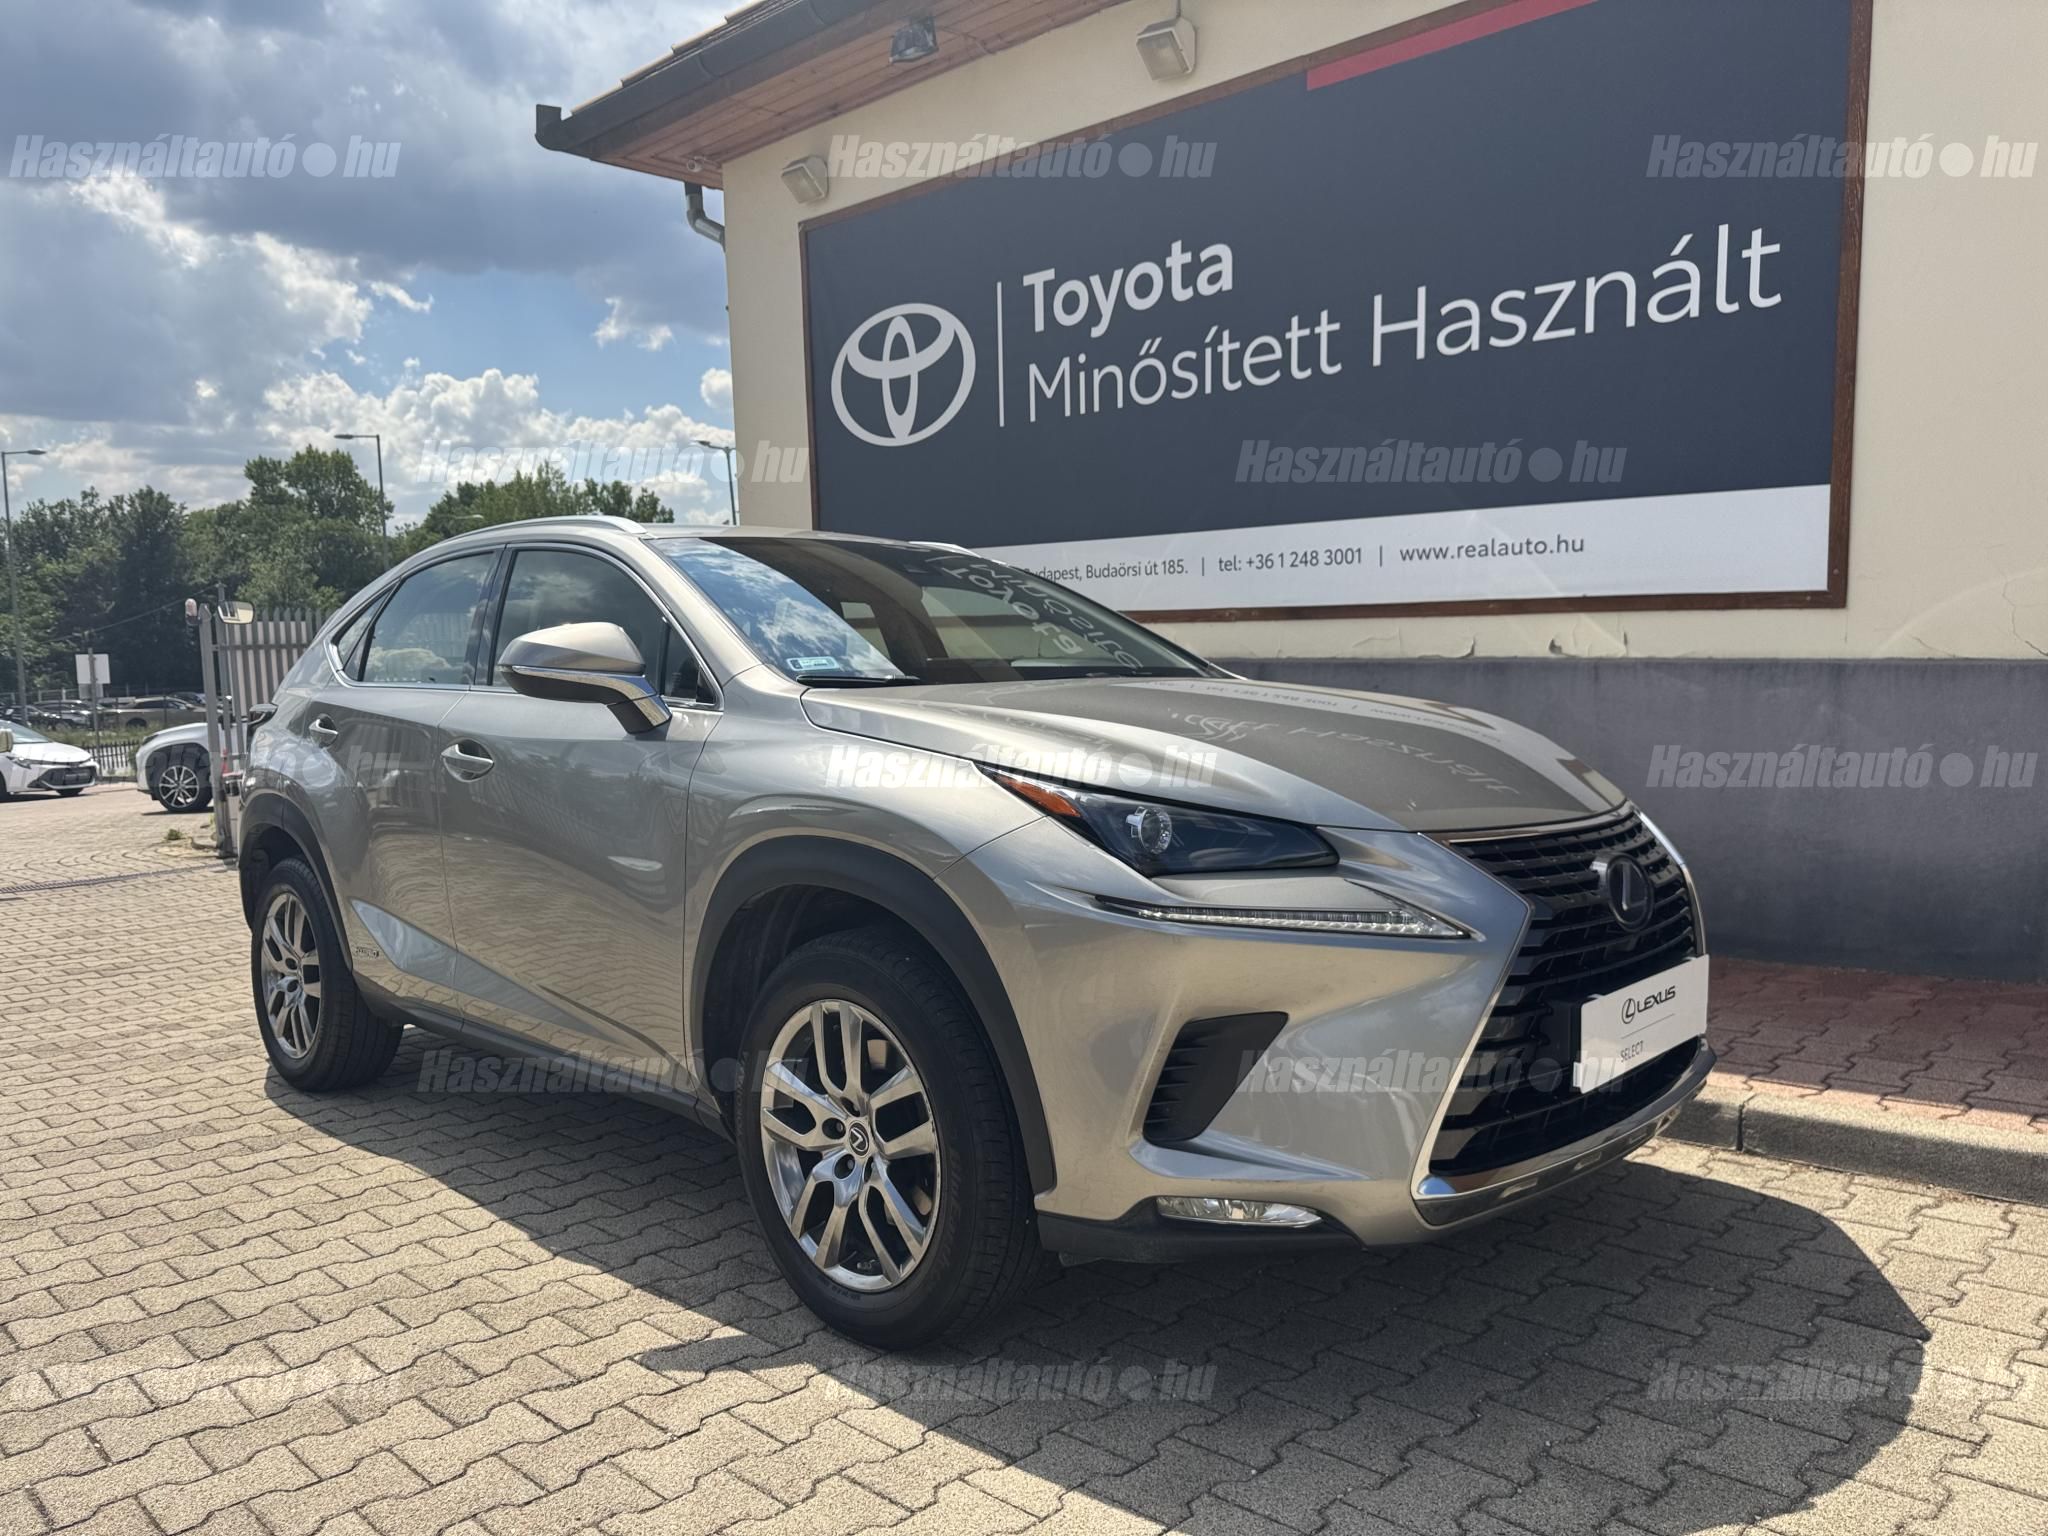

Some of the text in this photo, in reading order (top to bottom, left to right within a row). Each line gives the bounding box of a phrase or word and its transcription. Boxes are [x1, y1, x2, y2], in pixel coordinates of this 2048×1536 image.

[1022, 239, 1234, 338] Toyota
[1027, 223, 1783, 423] Minősített Használt
[1218, 556, 1242, 573] tel:
[1289, 550, 1320, 568] 248
[1323, 547, 1363, 566] 3001
[1400, 534, 1584, 562] www.realauto.hu
[1086, 561, 1141, 580] Budaörsi
[1144, 561, 1159, 576] út
[1162, 559, 1188, 576] 185.
[1636, 985, 1676, 1014] LEXUS
[1619, 1040, 1644, 1063] SELECT
